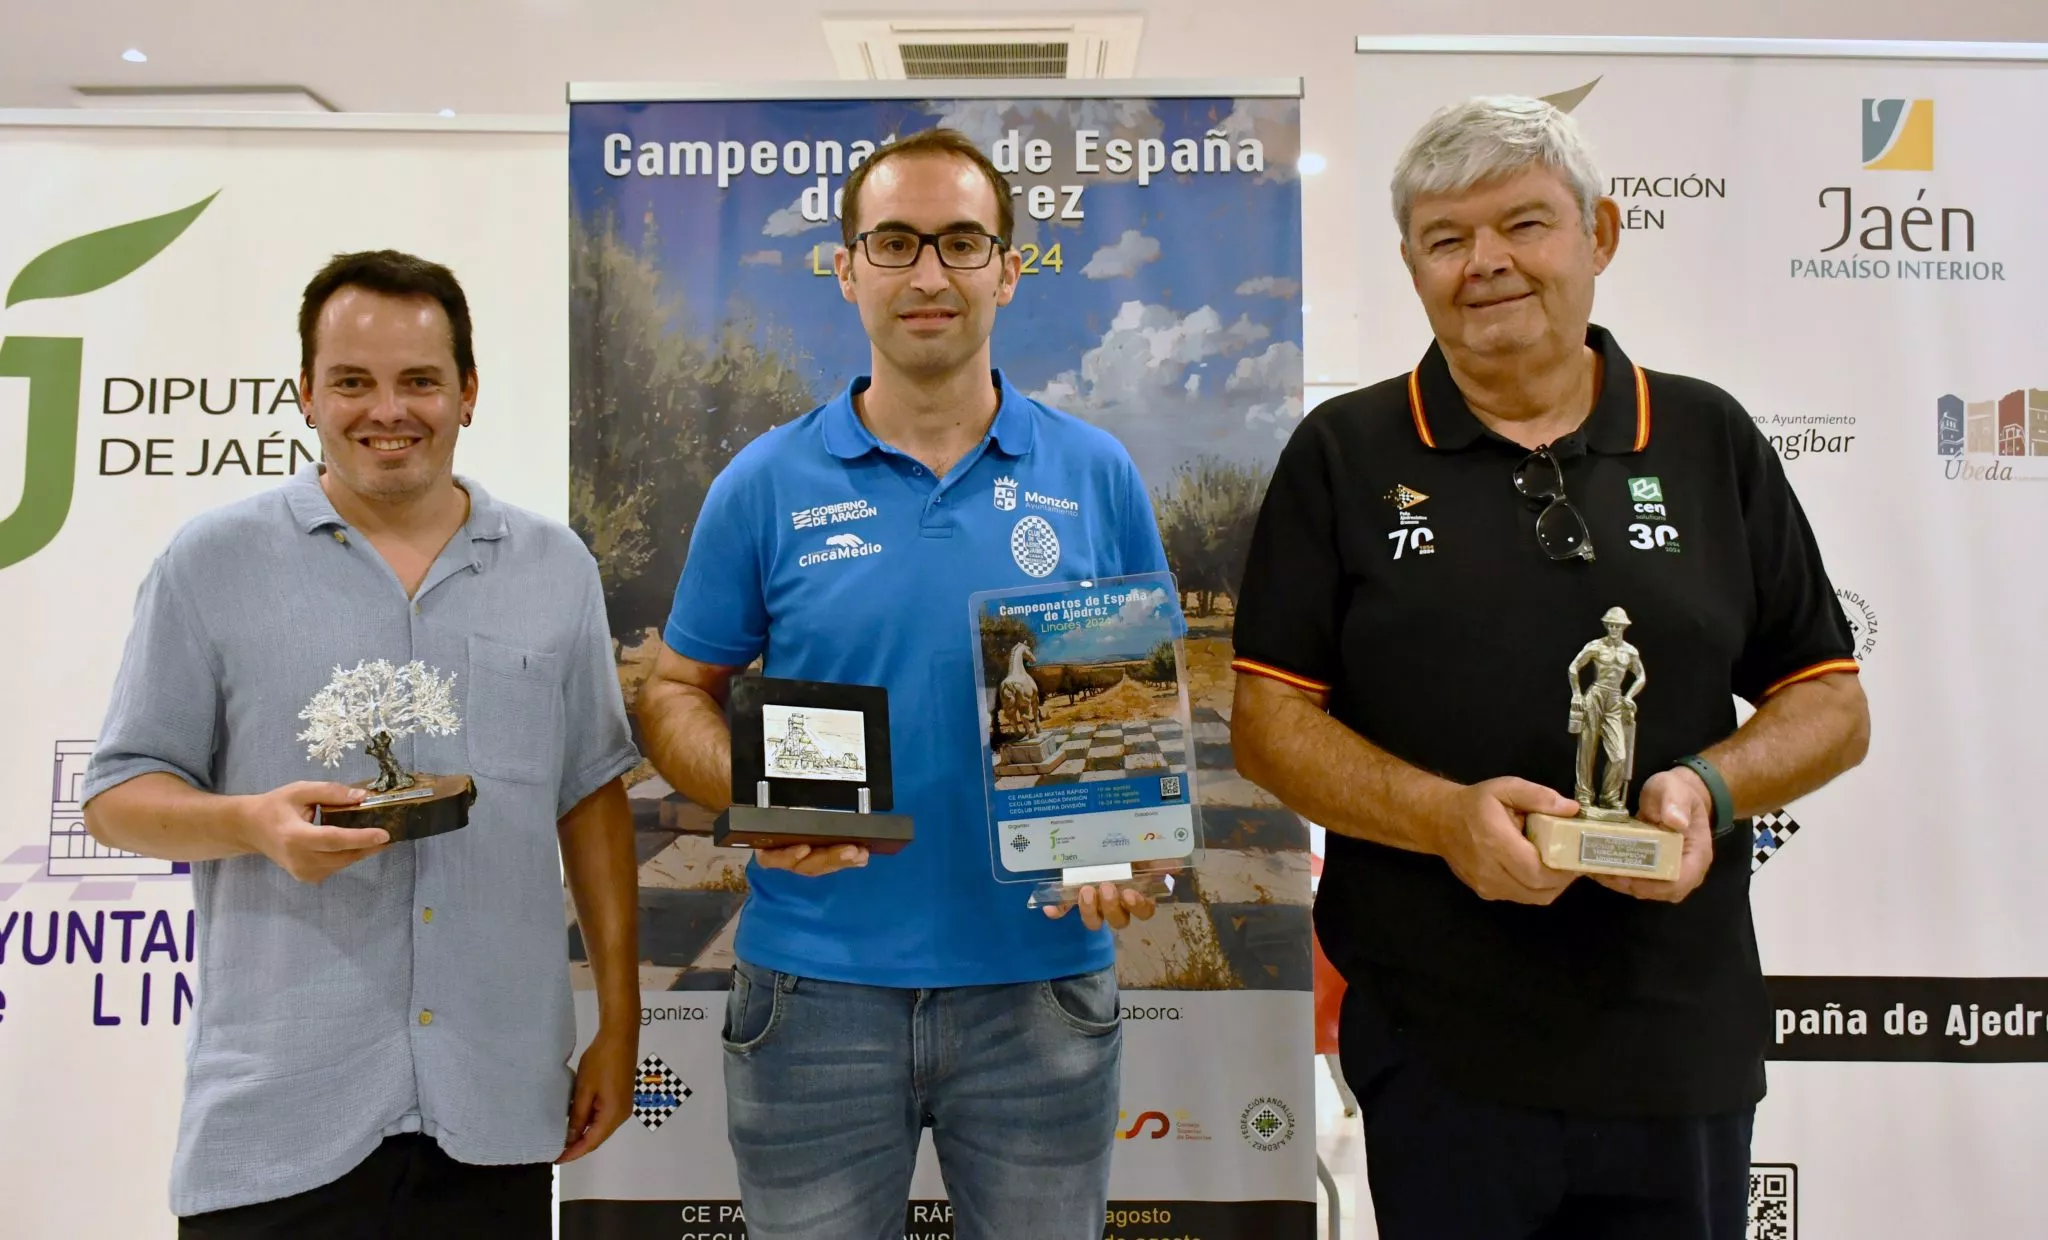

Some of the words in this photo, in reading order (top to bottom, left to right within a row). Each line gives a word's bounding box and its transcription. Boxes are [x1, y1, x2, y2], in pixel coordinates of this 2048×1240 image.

[604, 133, 896, 188] Campeona
[992, 129, 1052, 174] de
[1075, 129, 1264, 187] España
[1620, 205, 1664, 230] ÉN
[1819, 187, 1974, 252] Jaén
[1791, 254, 1890, 279] PARAÍSO
[1897, 261, 2006, 281] INTERIOR
[1772, 413, 1856, 427] Ayuntamiento
[99, 438, 175, 476] DE
[1945, 452, 2013, 481] Úbeda
[811, 499, 868, 517] GOBIERNO
[1025, 491, 1079, 511] Monzón
[1025, 502, 1079, 517] Ayuntamiento
[812, 516, 828, 527] DE
[1388, 527, 1434, 559] 70
[1628, 523, 1679, 550] 30
[799, 543, 882, 567] CincaMedio
[1000, 599, 1081, 616] Campeonatos
[1085, 596, 1100, 607] de
[1104, 591, 1148, 606] España
[1044, 611, 1058, 621] de
[1063, 607, 1108, 622] Ajedrez
[1041, 621, 1081, 633] Linares
[1085, 618, 1112, 629] 2024
[1836, 588, 1878, 635] ANDALUZA
[1862, 638, 1876, 654] DE
[1775, 1003, 1868, 1044] paña
[1884, 1003, 1929, 1036] de
[1945, 1003, 2048, 1047] Ajedr
[1241, 1097, 1265, 1140] FEDERACIÓN
[1266, 1097, 1295, 1129] ANDALUZA
[682, 1205, 712, 1223] CE
[720, 1206, 746, 1223] PA
[1105, 1208, 1172, 1228] agosto
